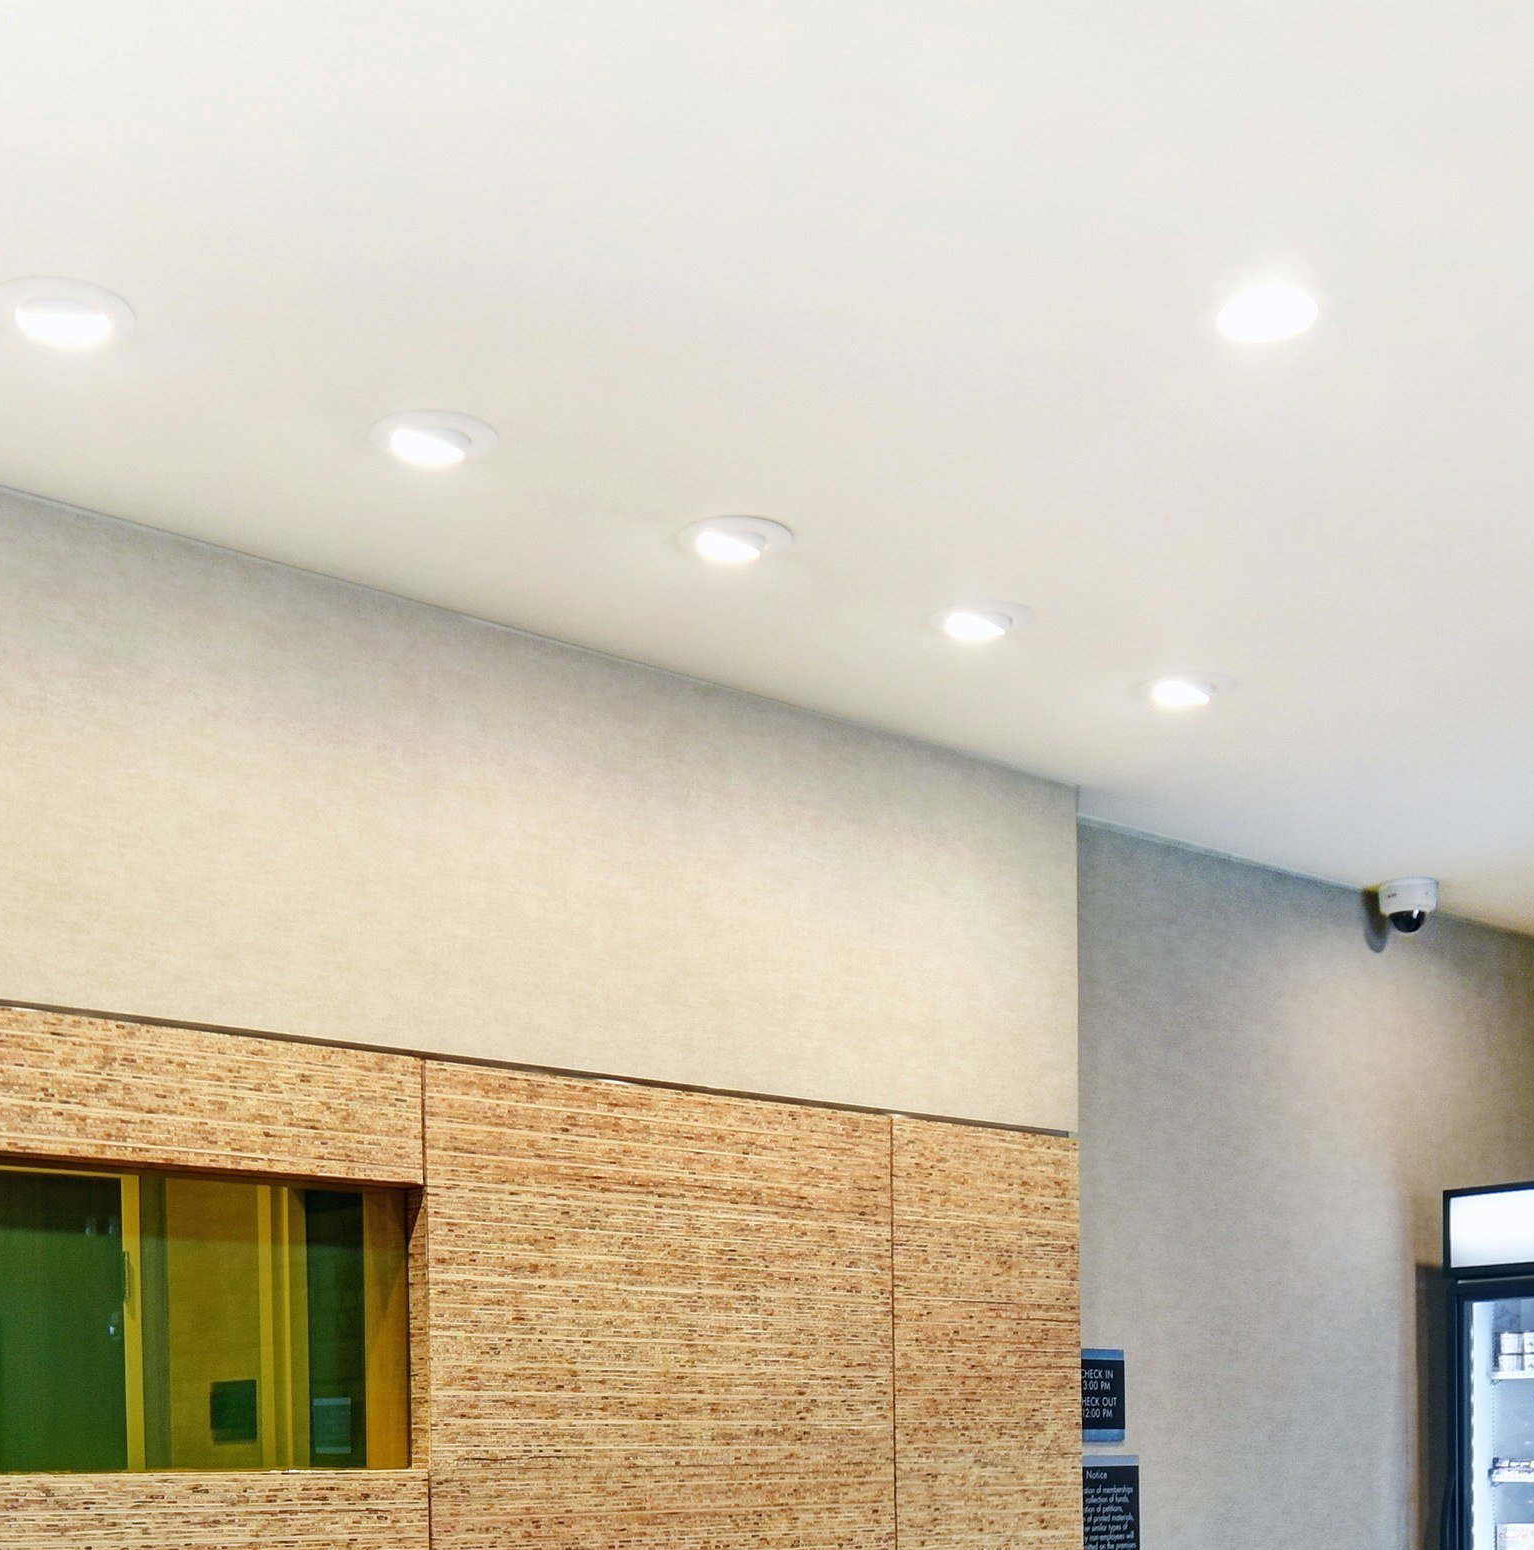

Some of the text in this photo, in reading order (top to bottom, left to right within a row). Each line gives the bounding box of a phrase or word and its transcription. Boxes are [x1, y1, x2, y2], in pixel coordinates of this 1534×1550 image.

[1105, 1370, 1114, 1379] IN
[1083, 1381, 1111, 1390] 3:00 PM
[1082, 1397, 1117, 1407] HECK OUT
[1103, 1409, 1113, 1418] PM
[1086, 1470, 1107, 1479] Notice
